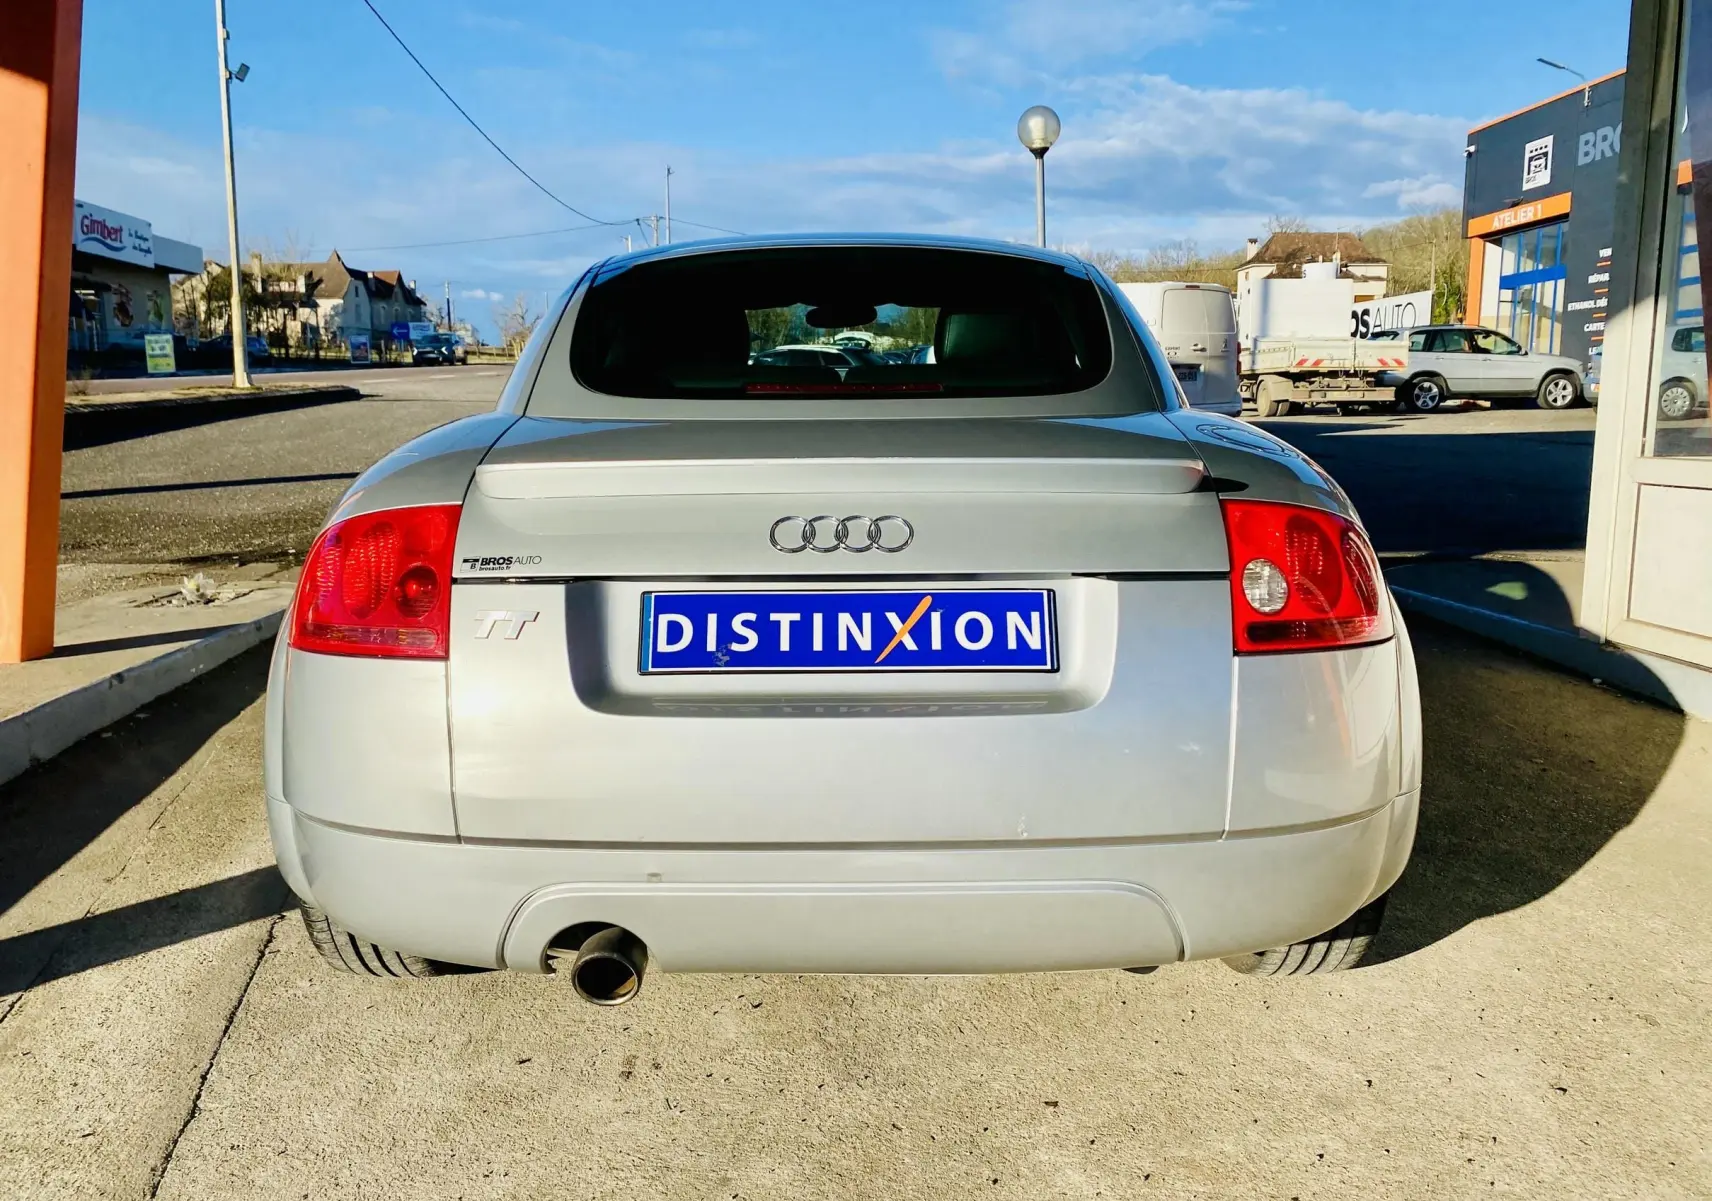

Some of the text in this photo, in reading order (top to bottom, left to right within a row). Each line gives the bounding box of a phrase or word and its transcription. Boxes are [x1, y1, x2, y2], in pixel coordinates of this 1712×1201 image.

[80, 213, 123, 244] Gimbert
[1491, 203, 1542, 230] ATELIER 1
[473, 609, 541, 640] TT
[656, 596, 1042, 663] DISTINXION
